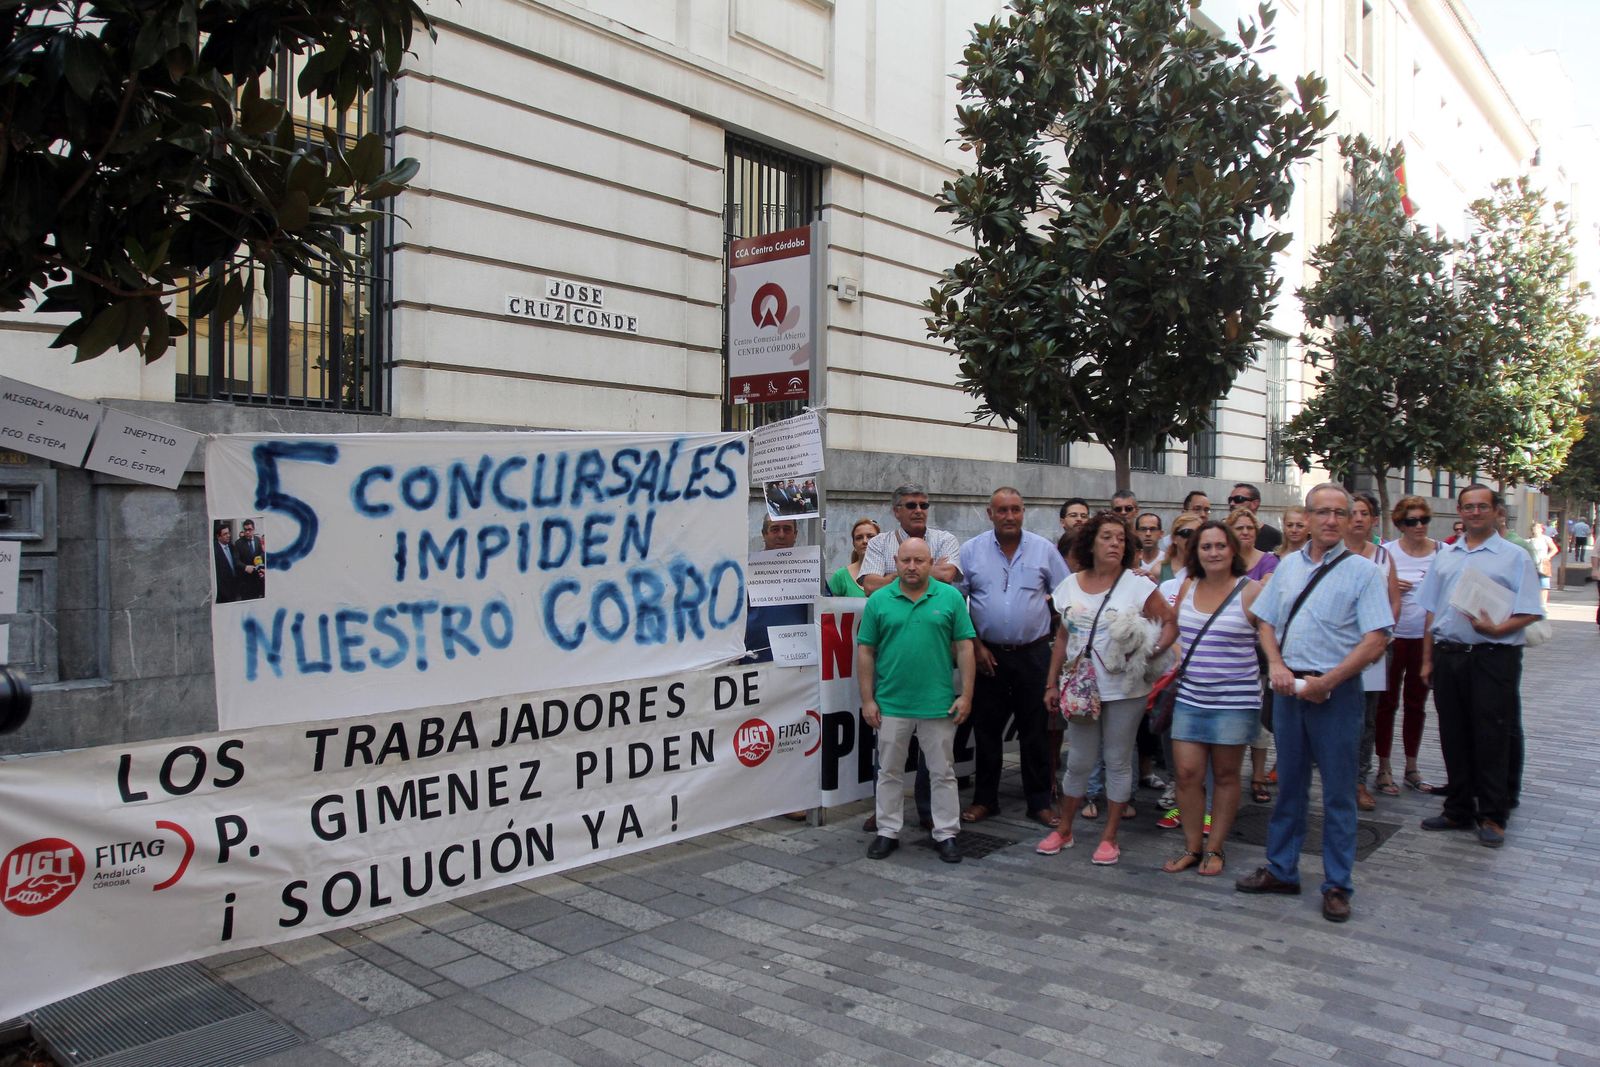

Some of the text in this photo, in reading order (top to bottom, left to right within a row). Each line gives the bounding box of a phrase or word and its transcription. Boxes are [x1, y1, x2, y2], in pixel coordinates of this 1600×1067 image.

[735, 238, 805, 258] CCA Centro Córdoba
[551, 282, 601, 304] JOSE
[510, 299, 637, 331] CRUZ CONDE
[734, 331, 806, 346] Centro Comercial Abierto
[737, 342, 801, 356] CENTRO CÓRDOBA
[1, 427, 67, 450] FCO. ESTEPA
[122, 426, 177, 447] INEPTITUD
[108, 455, 166, 476] FCO. ESTEPA
[253, 438, 746, 573] 5 CONCURSALES
[395, 508, 655, 581] IMPIDEN
[241, 558, 746, 682] NUESTRO COBRO
[117, 739, 245, 803] LOS
[713, 671, 760, 711] DE
[739, 724, 769, 748] UGT
[778, 721, 810, 740] FITAG
[215, 728, 715, 864] P. GIMENEZ PIDEN
[582, 804, 644, 850] YA
[8, 847, 76, 882] UGT
[95, 838, 165, 869] FITAG
